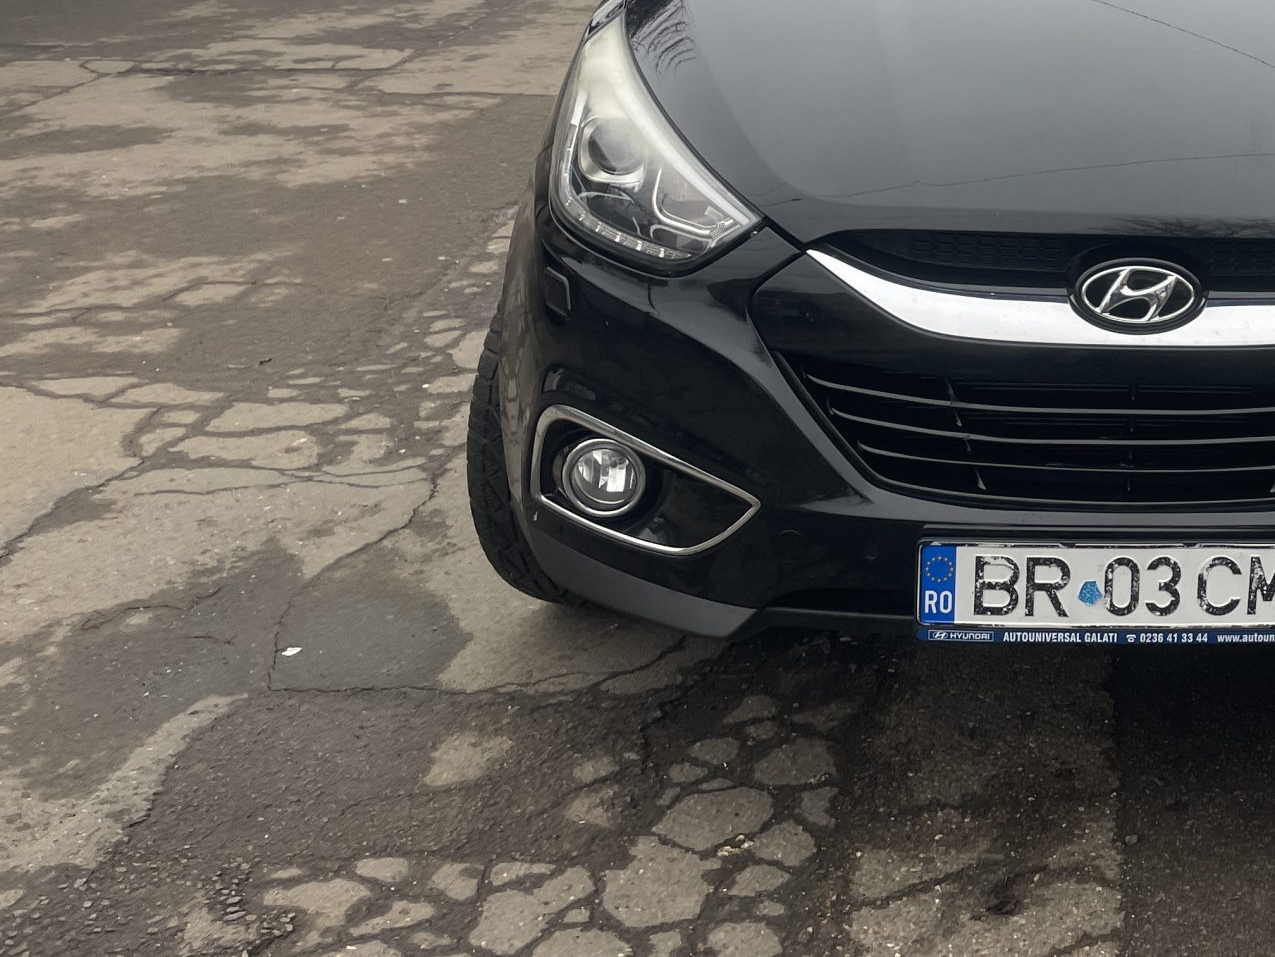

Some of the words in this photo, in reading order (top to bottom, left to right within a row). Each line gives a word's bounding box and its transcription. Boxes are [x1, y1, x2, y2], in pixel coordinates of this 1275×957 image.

[973, 555, 1071, 617] BR
[1104, 556, 1182, 617] 03
[924, 590, 953, 614] RO
[950, 632, 990, 641] HYUNDAI
[1003, 632, 1081, 643] AUTOUNIVERSAL
[1084, 632, 1118, 643] GALATI
[1139, 633, 1164, 643] 0236
[1166, 633, 1178, 643] 41
[1181, 633, 1194, 643] 33
[1196, 633, 1208, 643] 44
